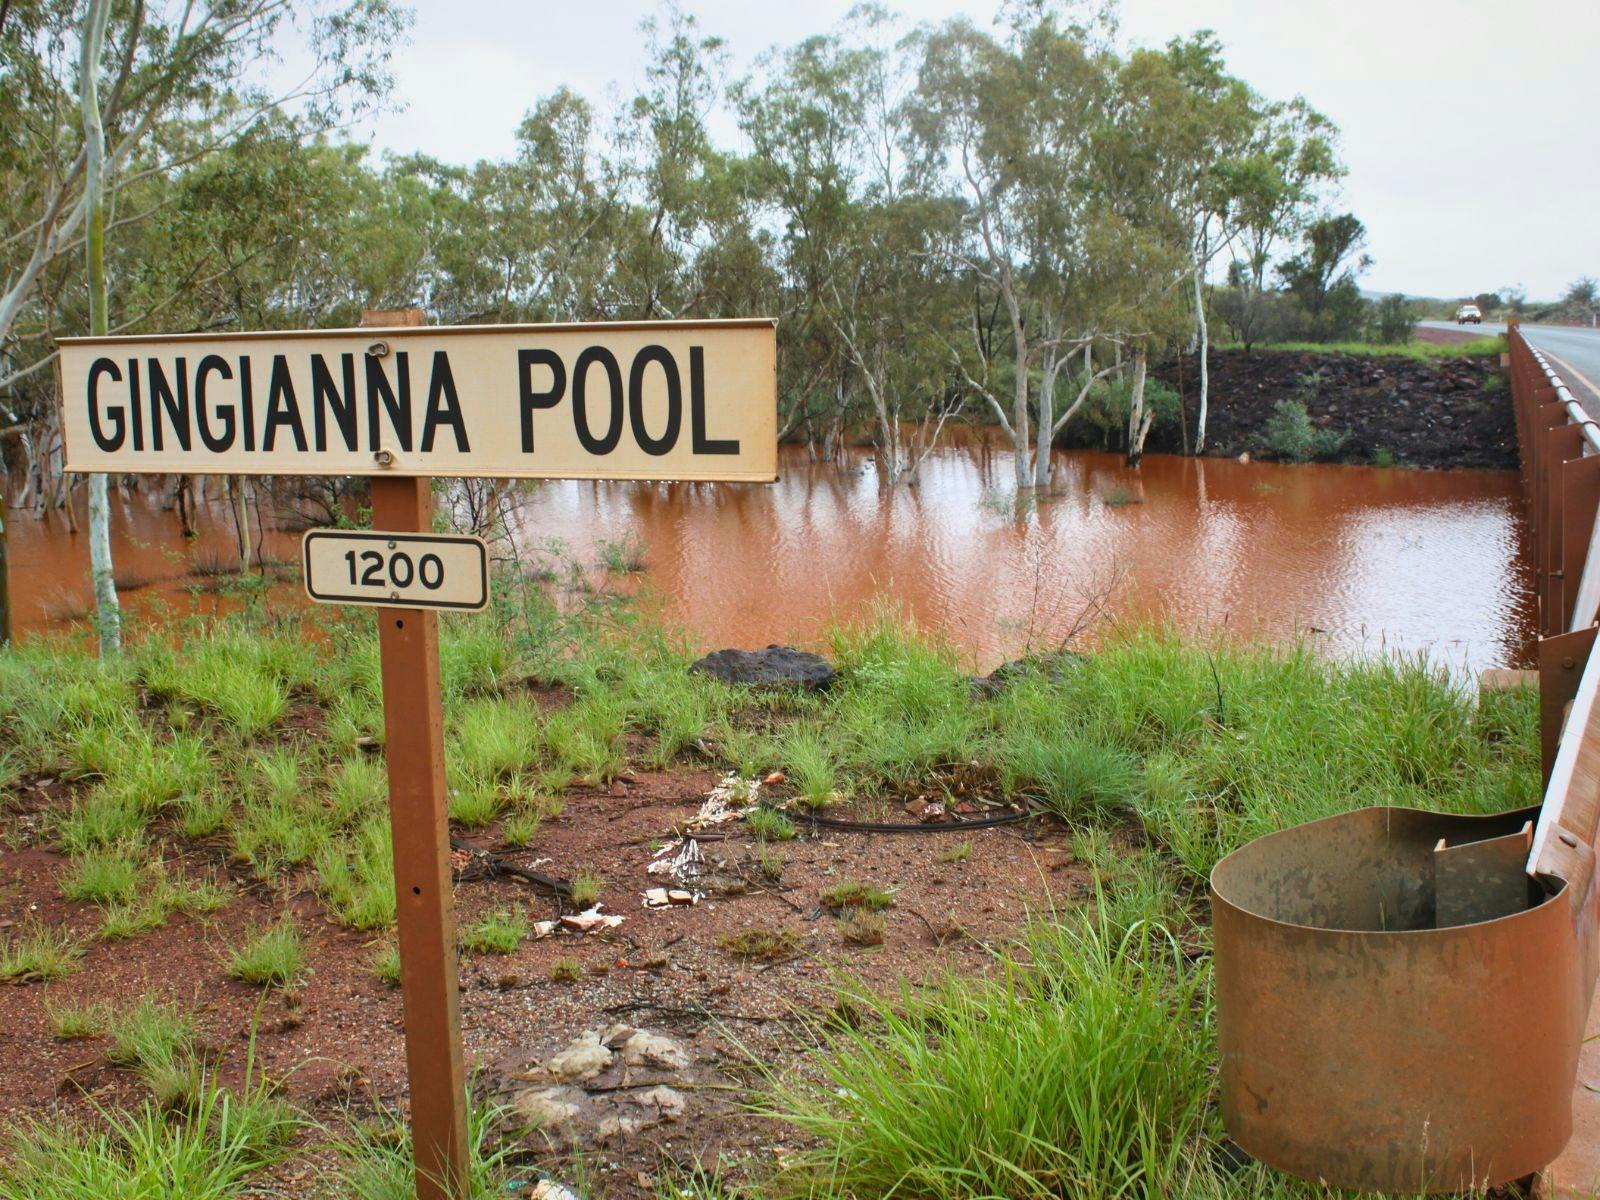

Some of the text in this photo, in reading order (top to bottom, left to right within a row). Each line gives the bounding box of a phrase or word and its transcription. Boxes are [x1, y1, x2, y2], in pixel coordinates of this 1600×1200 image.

[86, 344, 741, 457] GINGIANNA POOL
[343, 549, 446, 591] 1200
